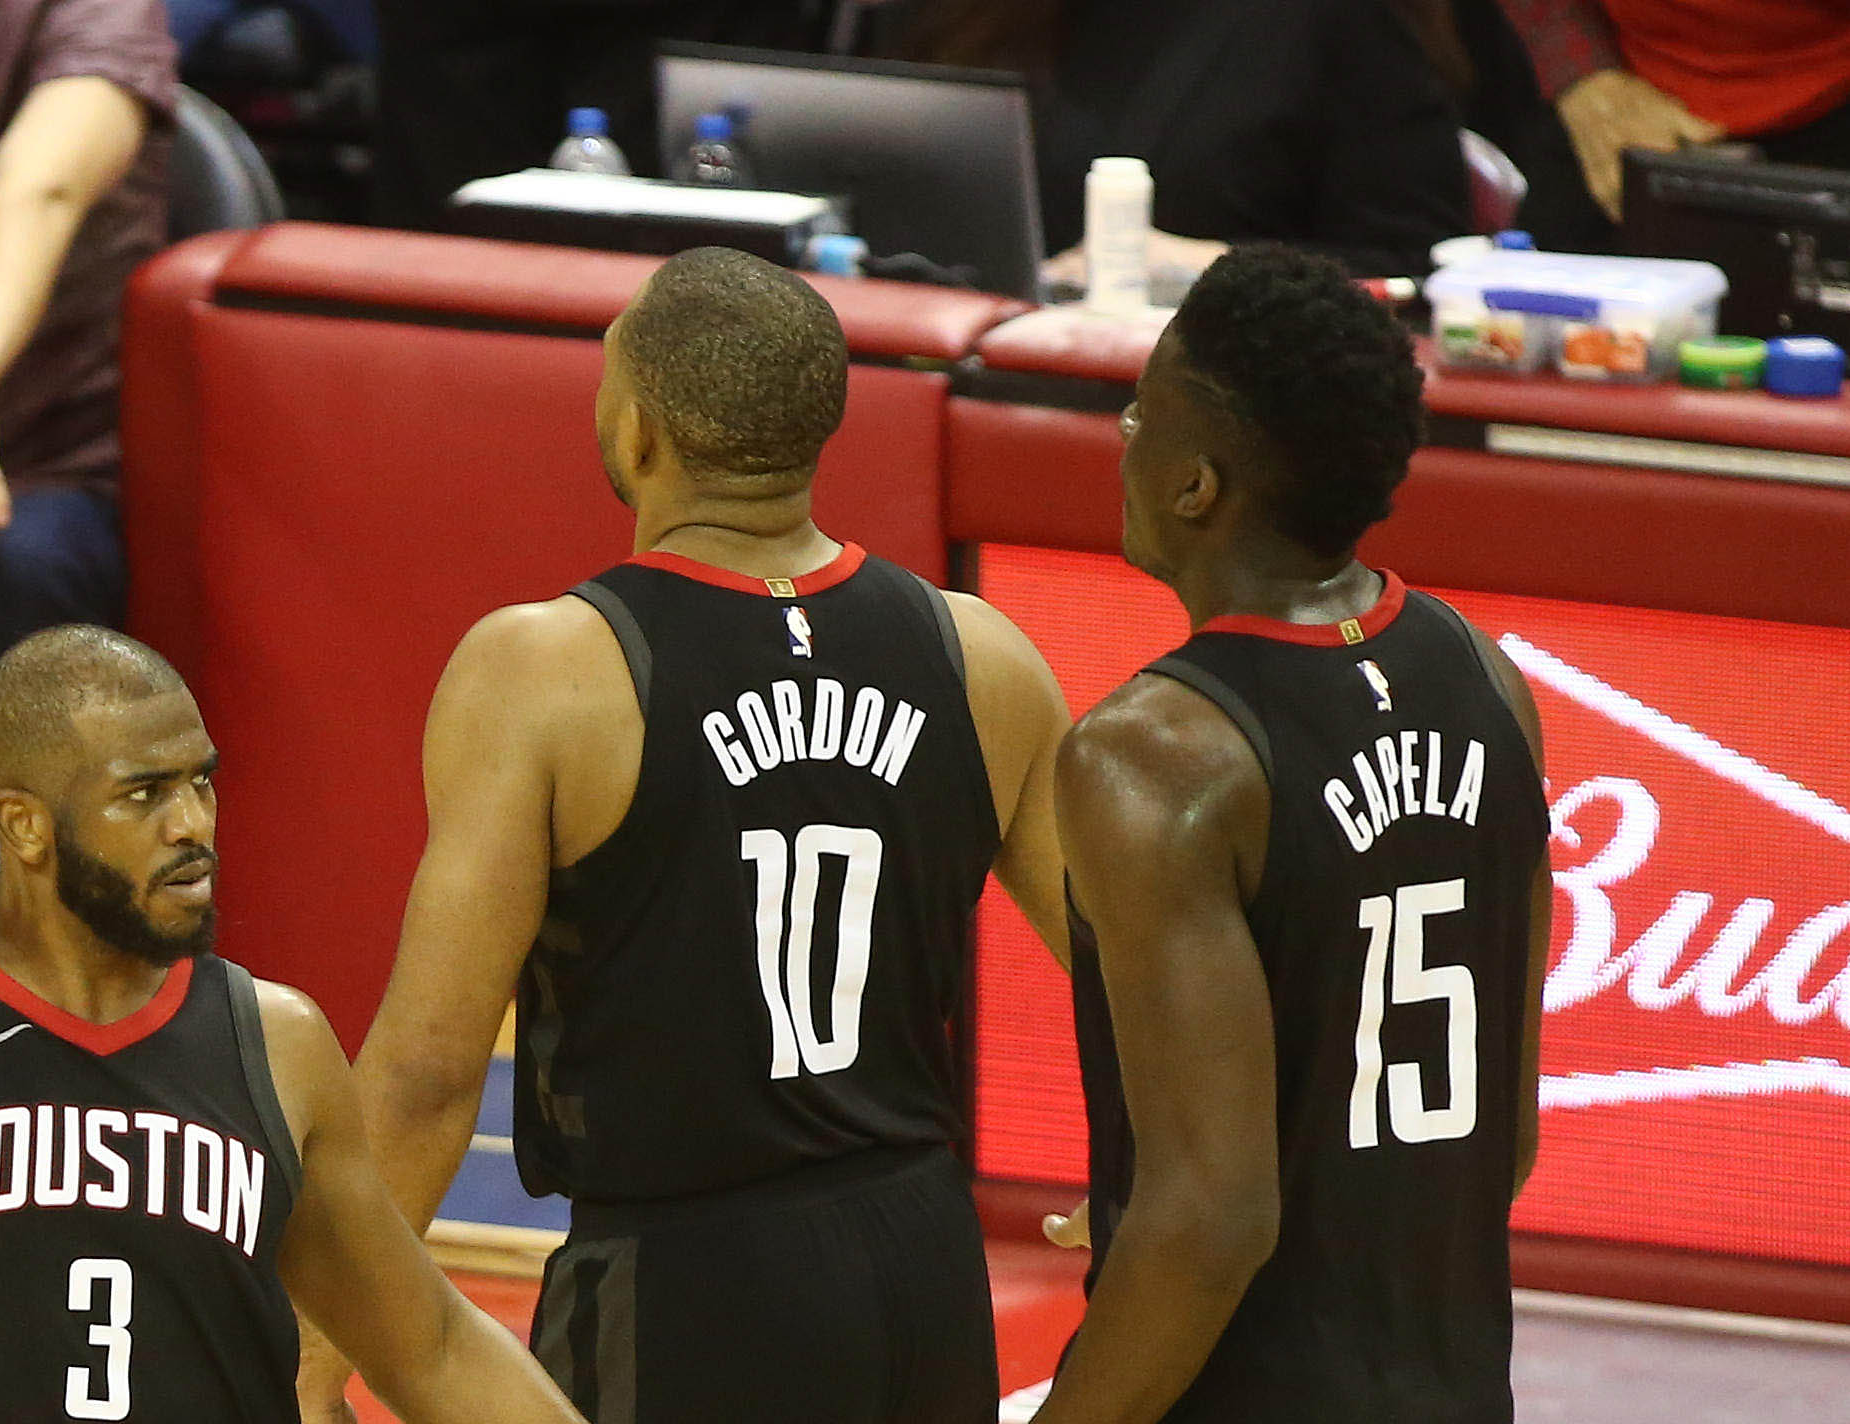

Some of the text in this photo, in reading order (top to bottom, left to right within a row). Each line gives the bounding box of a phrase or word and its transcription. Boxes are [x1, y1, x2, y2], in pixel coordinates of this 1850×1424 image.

[702, 677, 927, 787] GORDON
[1323, 730, 1485, 853] CAPELA
[740, 824, 883, 1080] 10
[1348, 878, 1477, 1149] 15
[64, 1257, 133, 1421] 3
